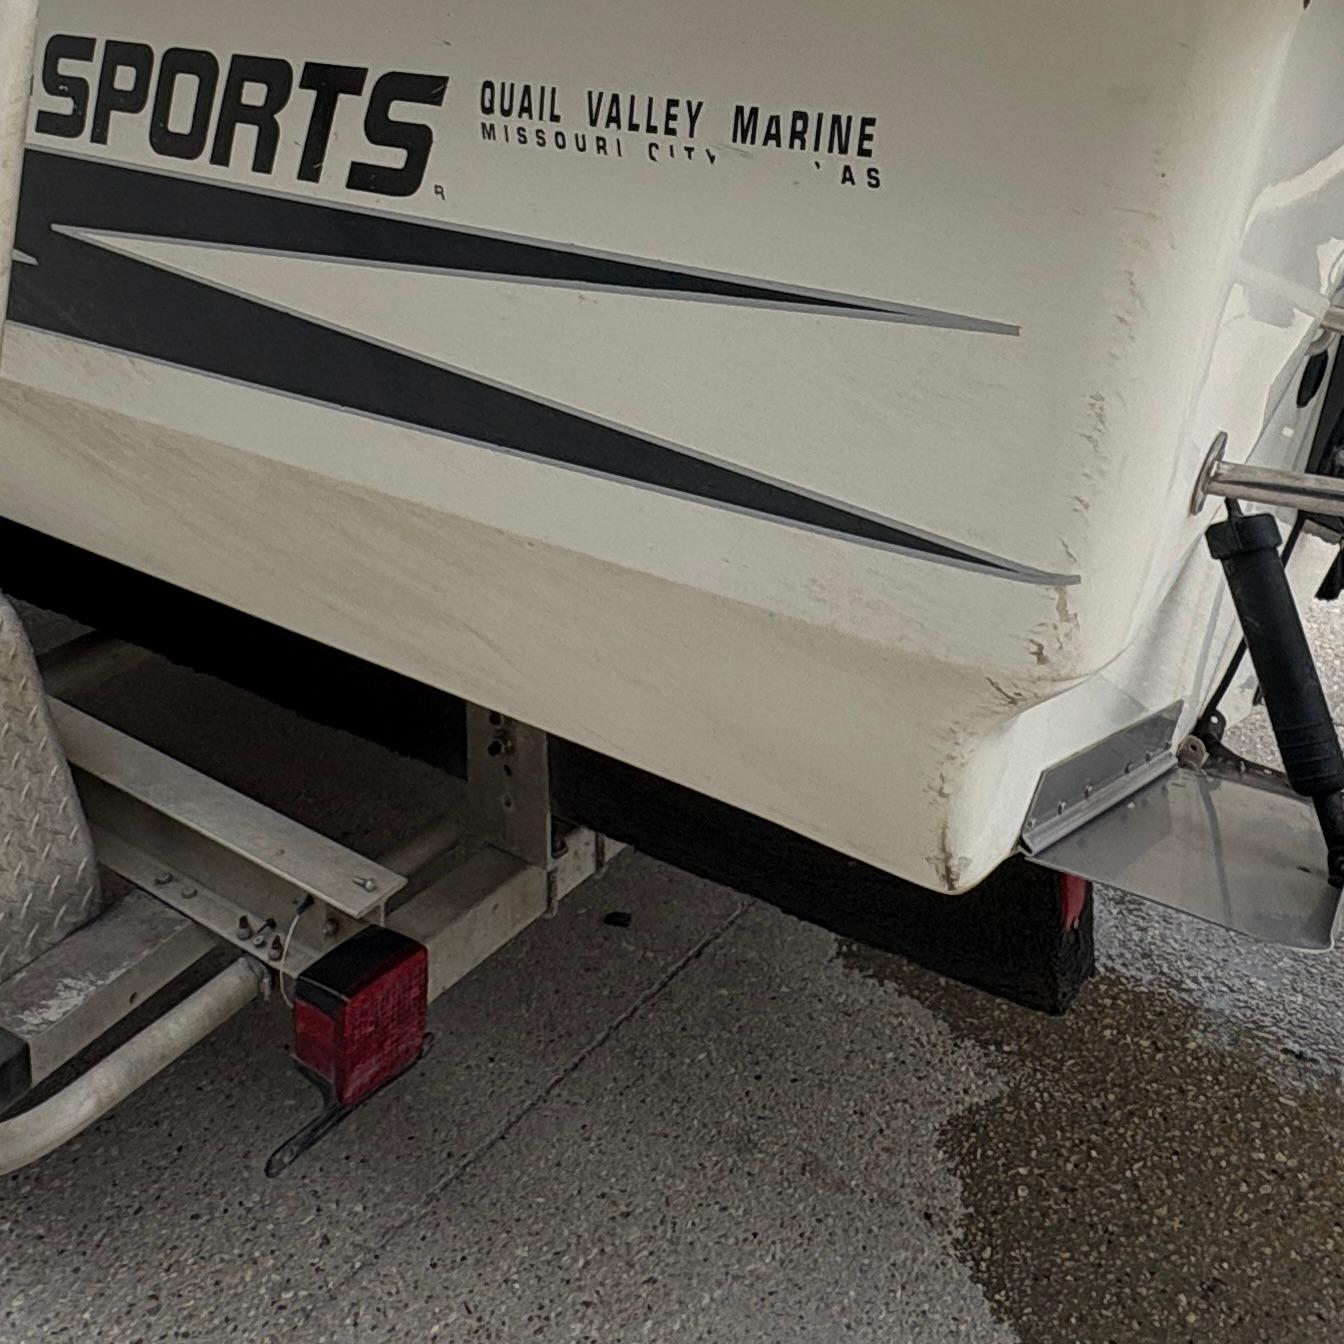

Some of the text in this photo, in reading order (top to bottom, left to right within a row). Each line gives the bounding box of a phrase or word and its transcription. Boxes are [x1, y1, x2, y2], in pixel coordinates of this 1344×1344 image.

[480, 79, 878, 158] QUAIL VALLEY MARINE
[481, 122, 623, 157] MISSOURI
